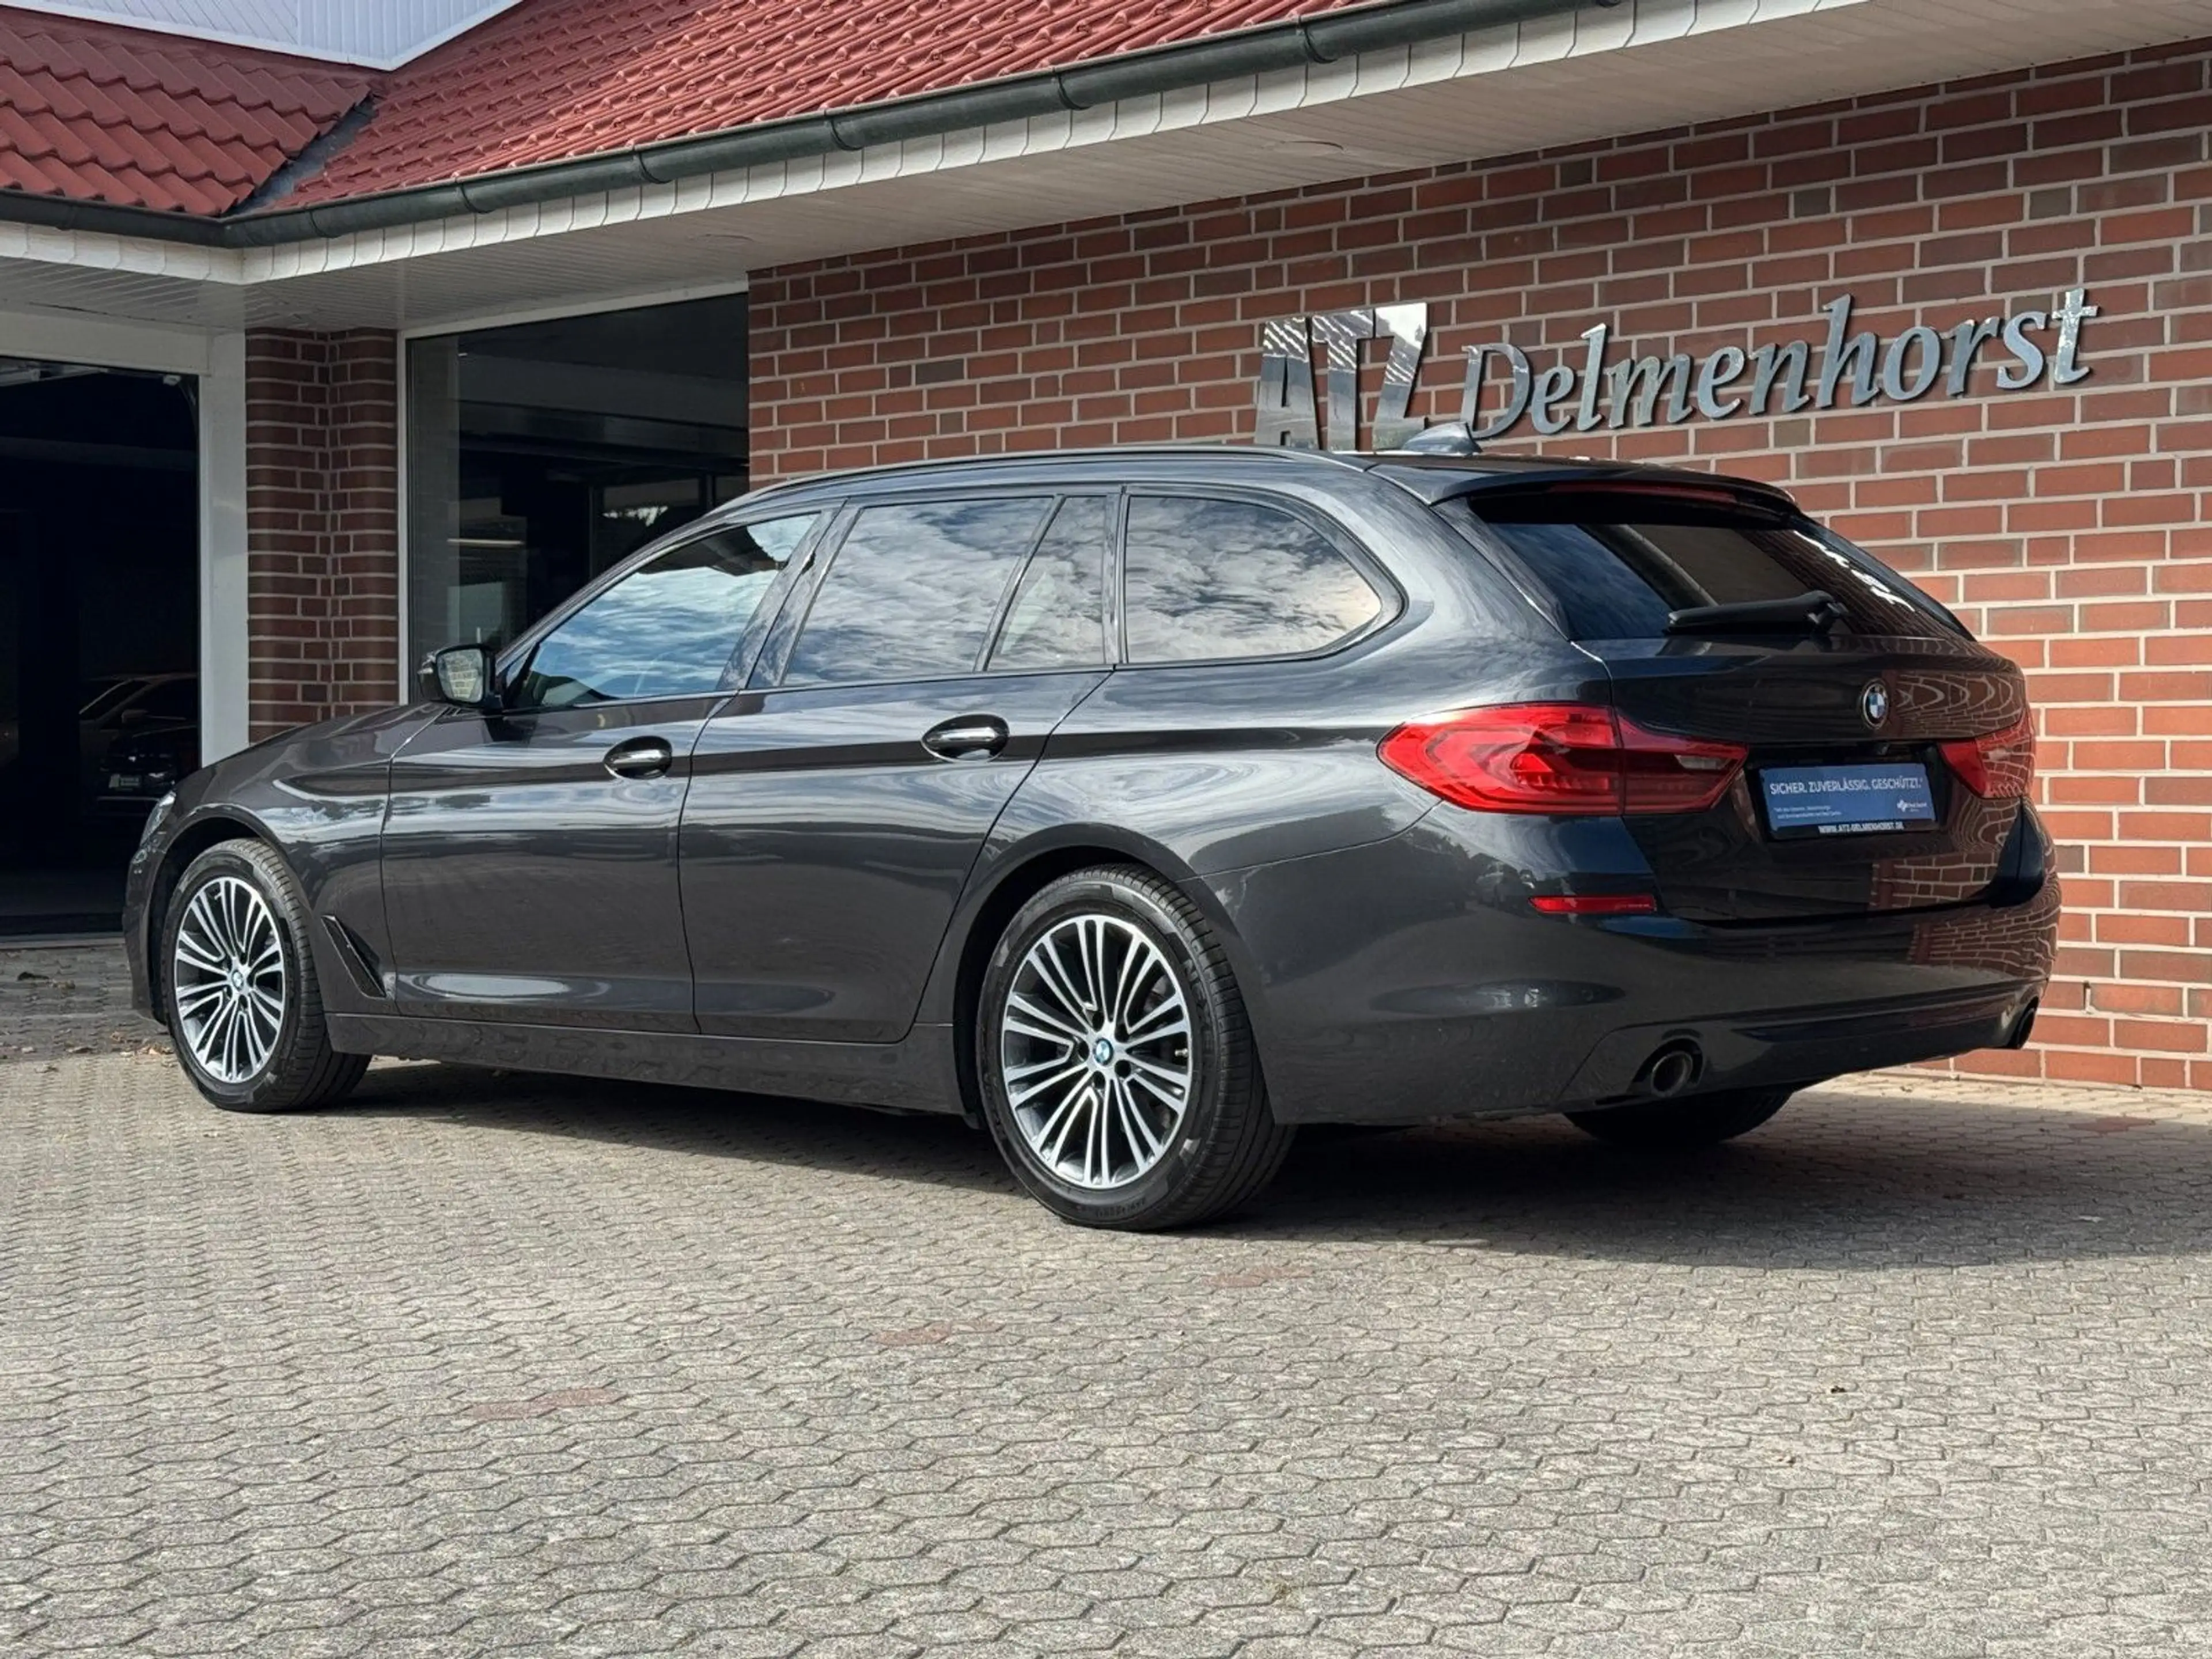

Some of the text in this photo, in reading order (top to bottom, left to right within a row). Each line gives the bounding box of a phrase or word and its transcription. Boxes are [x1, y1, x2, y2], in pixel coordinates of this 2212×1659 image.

[1254, 288, 2099, 451] ATZ Delmenhorst
[1770, 782, 1807, 795] SICHER.
[1809, 778, 1871, 793] ZUVERLÄSSIG.
